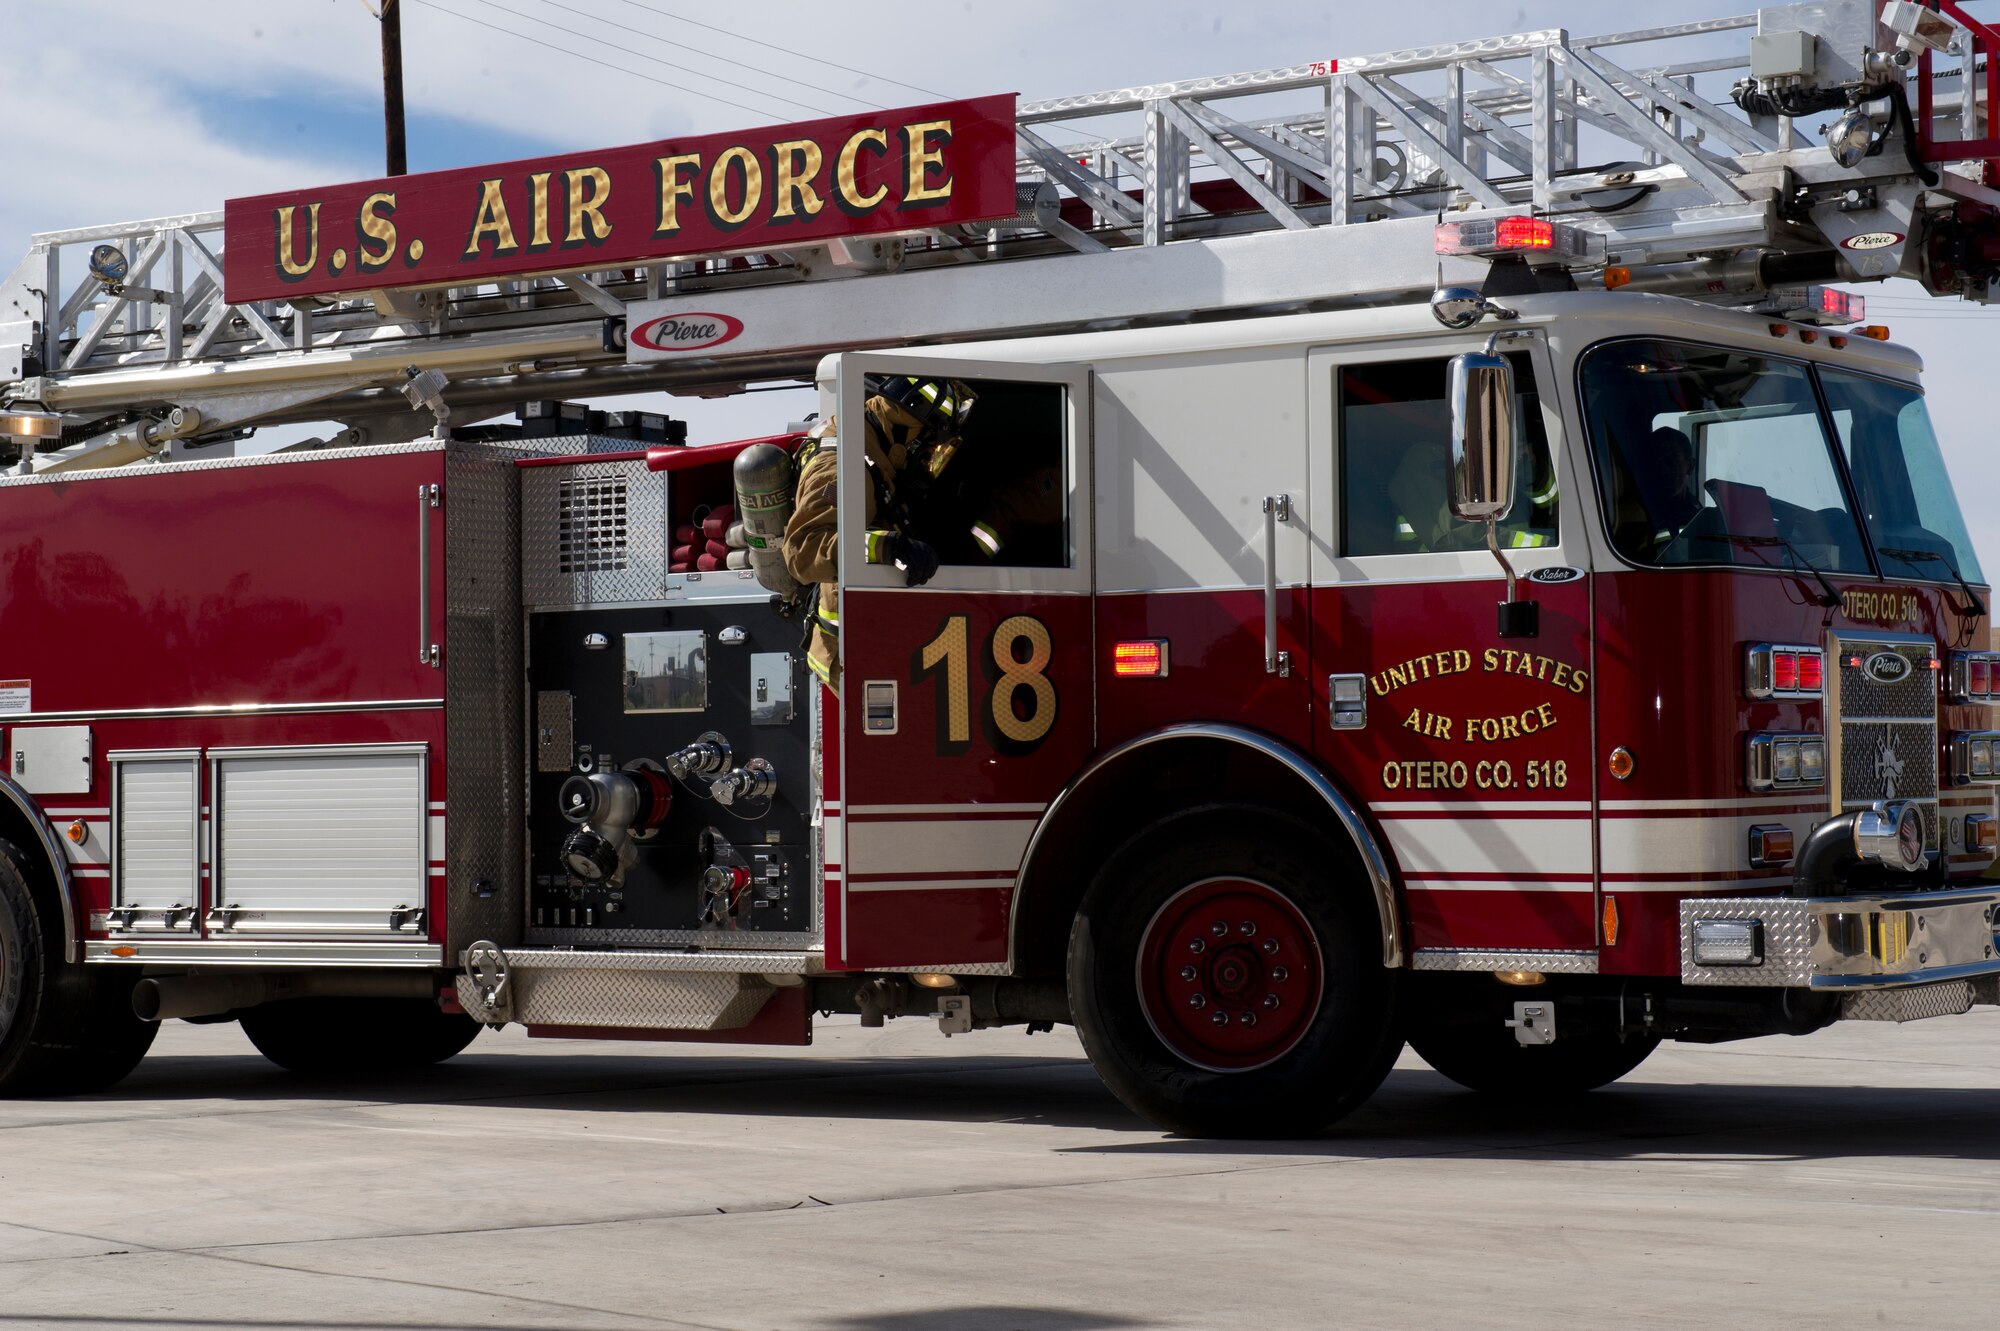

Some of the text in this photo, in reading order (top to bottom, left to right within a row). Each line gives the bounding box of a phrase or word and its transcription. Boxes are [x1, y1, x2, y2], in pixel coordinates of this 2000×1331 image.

[1309, 62, 1326, 77] 75
[274, 119, 953, 279] U.S. AIR FORCE
[1852, 236, 1890, 247] Pierce
[655, 320, 717, 345] Pierce
[739, 491, 788, 507] SA MS
[1540, 569, 1569, 580] Saber
[1841, 591, 1918, 621] OTERO CO. 518
[921, 615, 1057, 743] 18
[1370, 648, 1589, 696] UNITED STATES
[1873, 657, 1902, 675] Pierce
[1402, 702, 1557, 742] AIR FORCE
[1382, 760, 1568, 789] OTERO CO. 518
